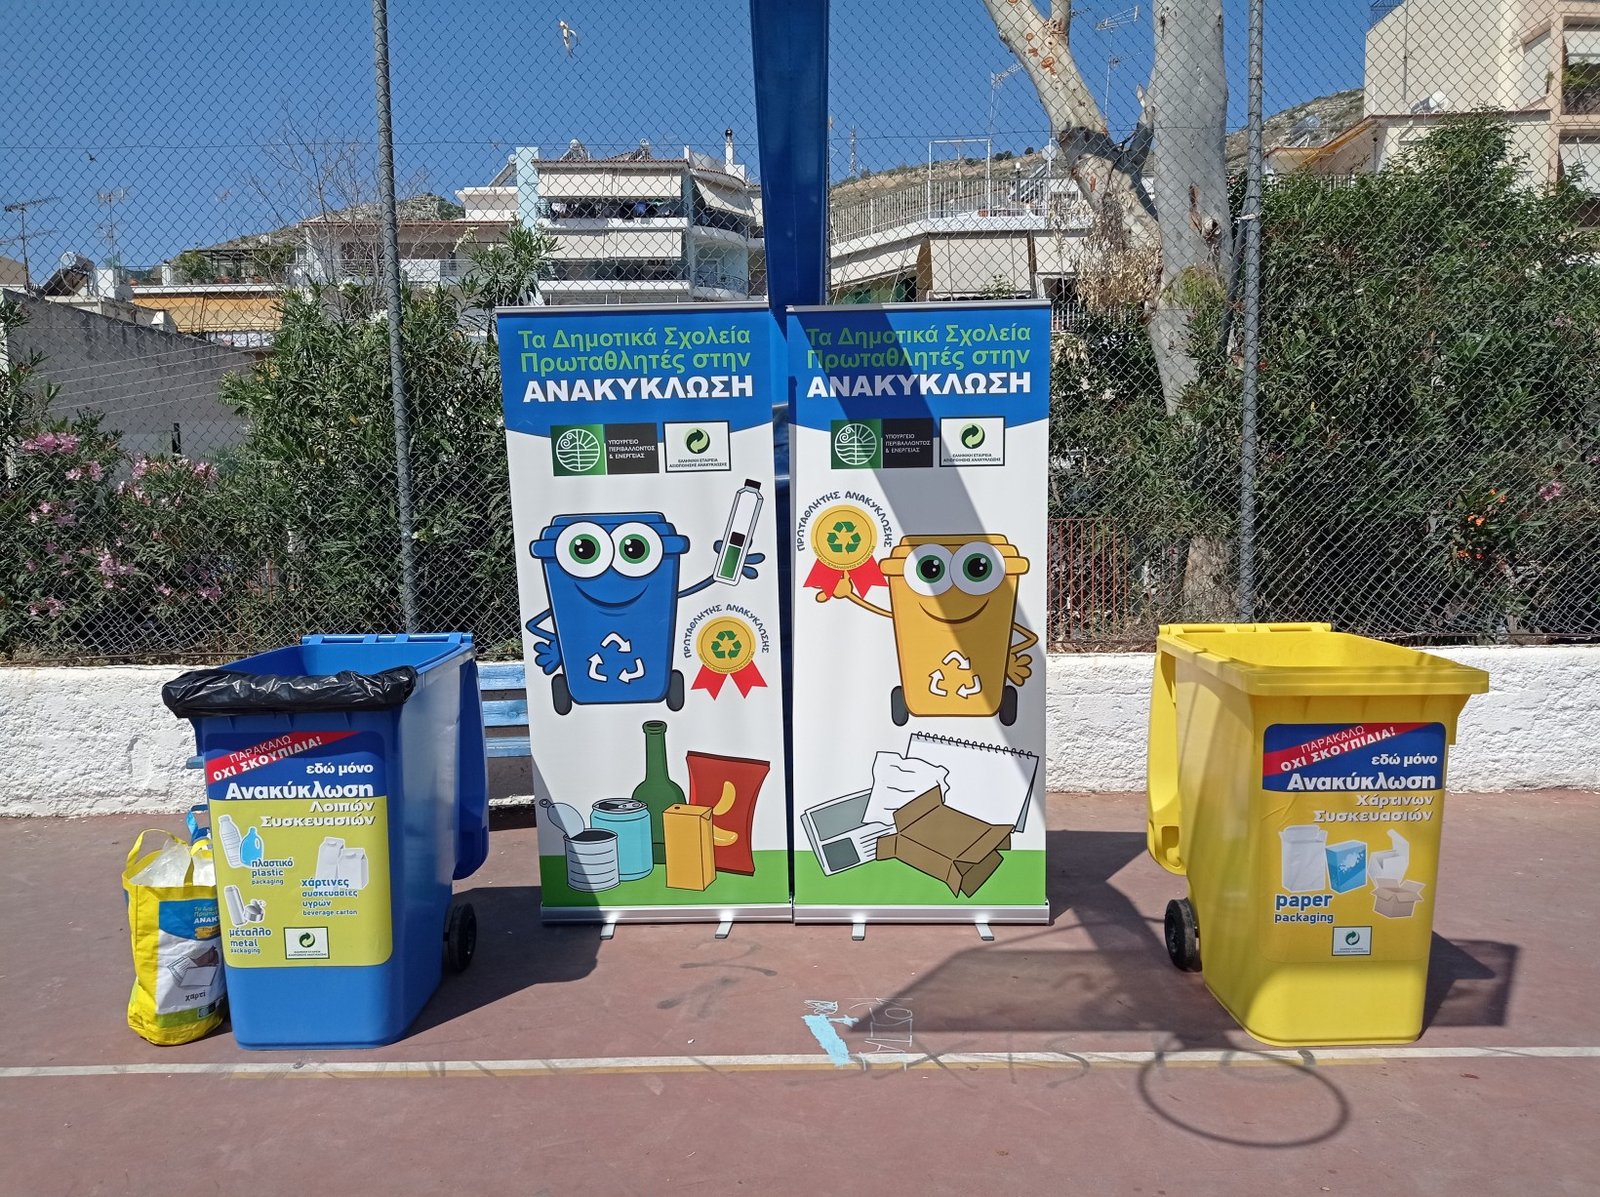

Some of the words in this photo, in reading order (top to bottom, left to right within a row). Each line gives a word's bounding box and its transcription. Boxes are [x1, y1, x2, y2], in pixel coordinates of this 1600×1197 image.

[518, 330, 546, 348] Τα
[553, 327, 657, 351] Δημοτικά
[664, 325, 750, 349] Σχολεία
[806, 327, 831, 346] Τα
[838, 325, 938, 348] Δημοτικά
[946, 322, 1030, 346] Σχολεία
[520, 351, 685, 377] Πρωταθλητές
[692, 352, 751, 373] στην
[807, 348, 964, 370] Πρωταθλητές
[972, 349, 1030, 369] στην
[523, 375, 753, 403] ΑΝΑΚΥΚΛΩΣΗ
[807, 371, 1031, 398] ΑΝΑΚΥΚΛΩΣΗ
[797, 491, 841, 552] ΠΡΩΤΑΘΛΗΤΗΣ
[845, 490, 893, 548] ΑΝΑΚΥΚΛΩΣΗΣ
[683, 605, 722, 658] ΠΡΩΤΑΘΛΗΤΗΣ
[726, 604, 769, 653] ΑΝΑΚΥΚΛΩΣΗΣ
[1300, 725, 1366, 753] ΠΑΡΑΚΑΛΩ
[229, 735, 292, 764] ΠΑΡΑΚΑΛΩ
[1280, 758, 1307, 772] ΟΧΙ
[1311, 726, 1396, 763] ΣΚΟΥΠΙΔΙΑ!
[213, 766, 237, 781] ΟΧΙ
[240, 736, 322, 772] ΣΚΟΥΠΙΔΙΑ!
[1371, 754, 1401, 765] εδώ
[1403, 753, 1437, 767] μόνο
[306, 762, 335, 774] εδώ
[338, 761, 373, 776] μόνο
[1287, 772, 1436, 791] Ανακύκλωση
[225, 781, 374, 800] Ανακύκλωση
[309, 800, 375, 812] Λοιπών
[1356, 794, 1434, 807] Χάρτινων
[261, 814, 376, 828] Συσκευασιών
[1313, 810, 1433, 823] Συσκευασιών
[252, 858, 293, 868] πλαστικό
[251, 869, 284, 878] plastic
[301, 878, 349, 888] χάρτινες
[302, 890, 358, 898] συσκευασίες
[1275, 893, 1333, 910] paper
[302, 900, 331, 908] υγρών
[1274, 913, 1334, 923] packaging
[229, 927, 272, 937] μέταλλο
[230, 939, 258, 947] metal
[185, 990, 206, 1002] χαρτί
